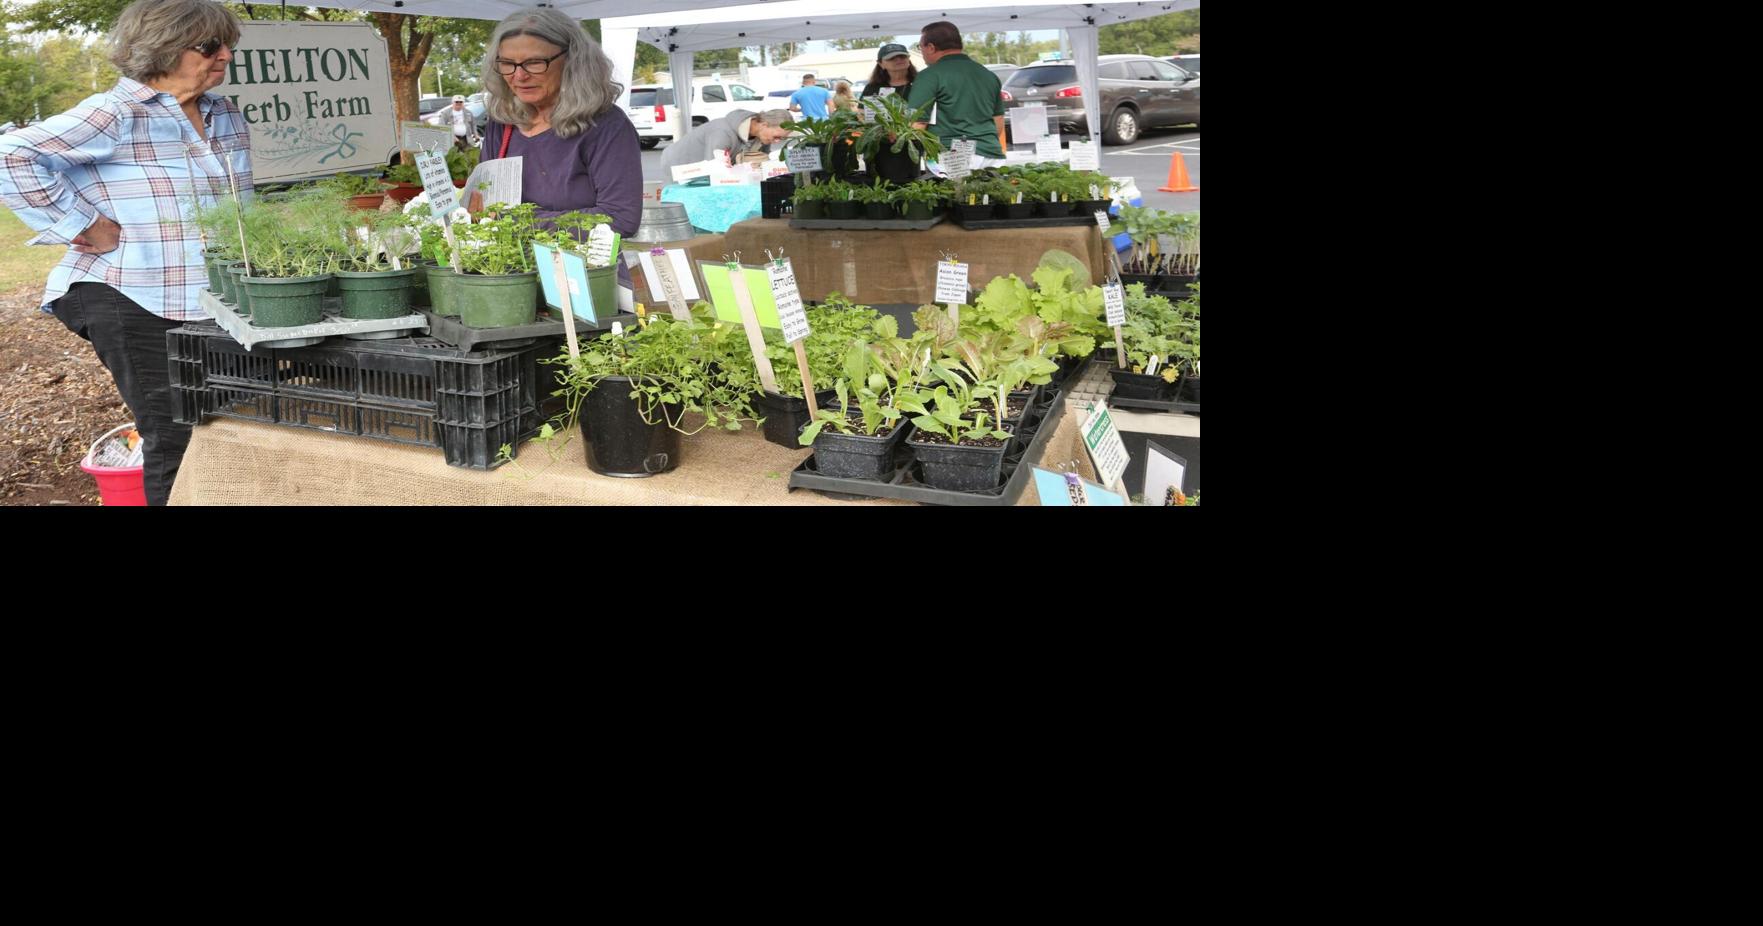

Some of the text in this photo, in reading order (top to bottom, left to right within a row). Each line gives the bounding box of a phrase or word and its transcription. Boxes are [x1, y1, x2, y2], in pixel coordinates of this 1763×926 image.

[229, 47, 370, 85] HELTON
[302, 90, 372, 120] Farm
[772, 274, 795, 291] LETTUCE
